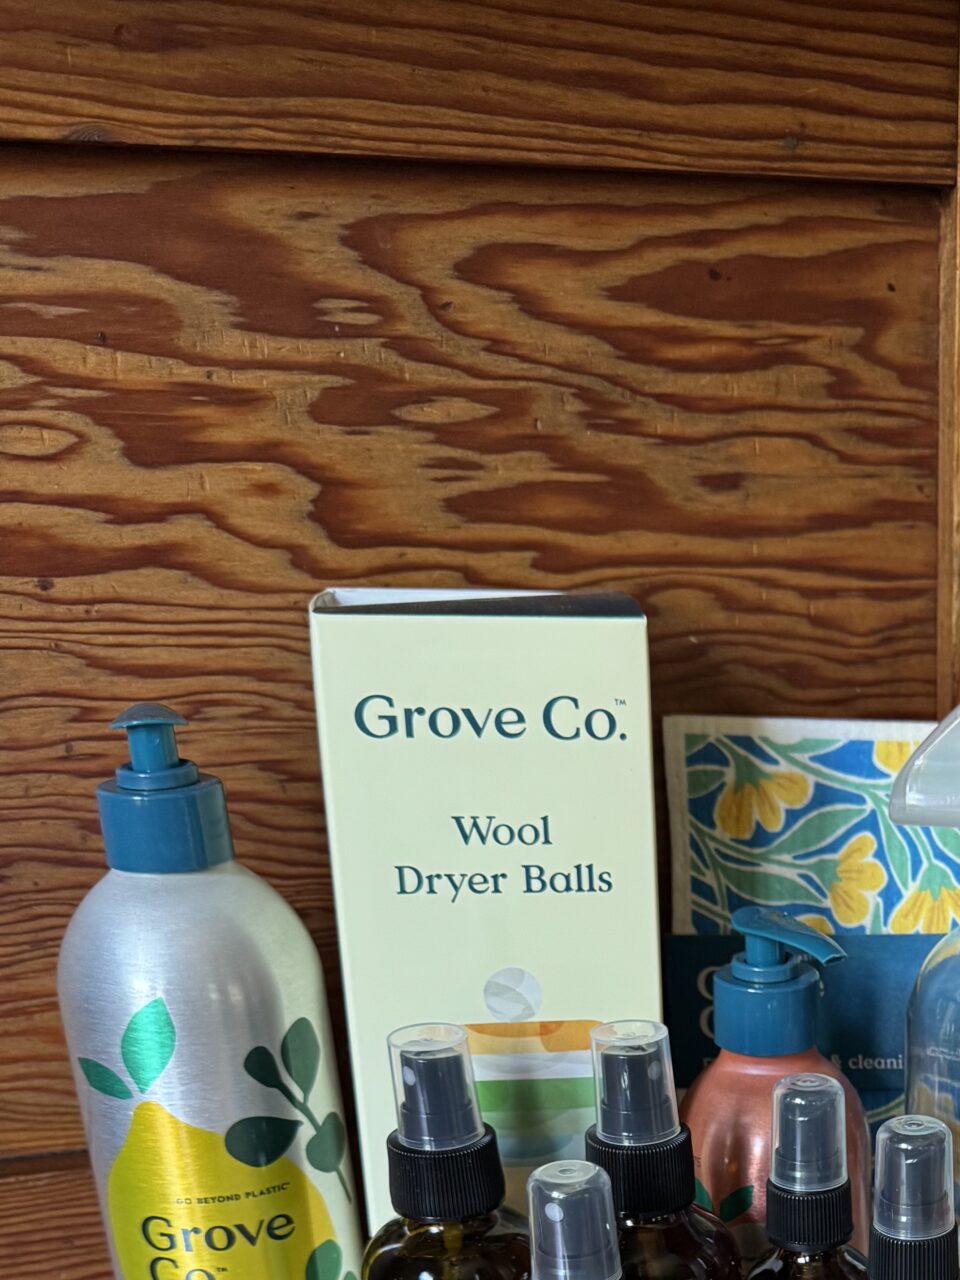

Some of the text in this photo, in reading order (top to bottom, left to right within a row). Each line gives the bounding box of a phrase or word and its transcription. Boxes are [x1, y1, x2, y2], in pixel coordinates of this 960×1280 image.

[354, 694, 527, 739] Grove
[451, 815, 553, 846] Wool
[394, 863, 613, 903] Dryer Balls
[848, 1053, 904, 1070] cleani
[196, 1193, 242, 1205] BEYOND
[141, 1212, 296, 1253] Grove
